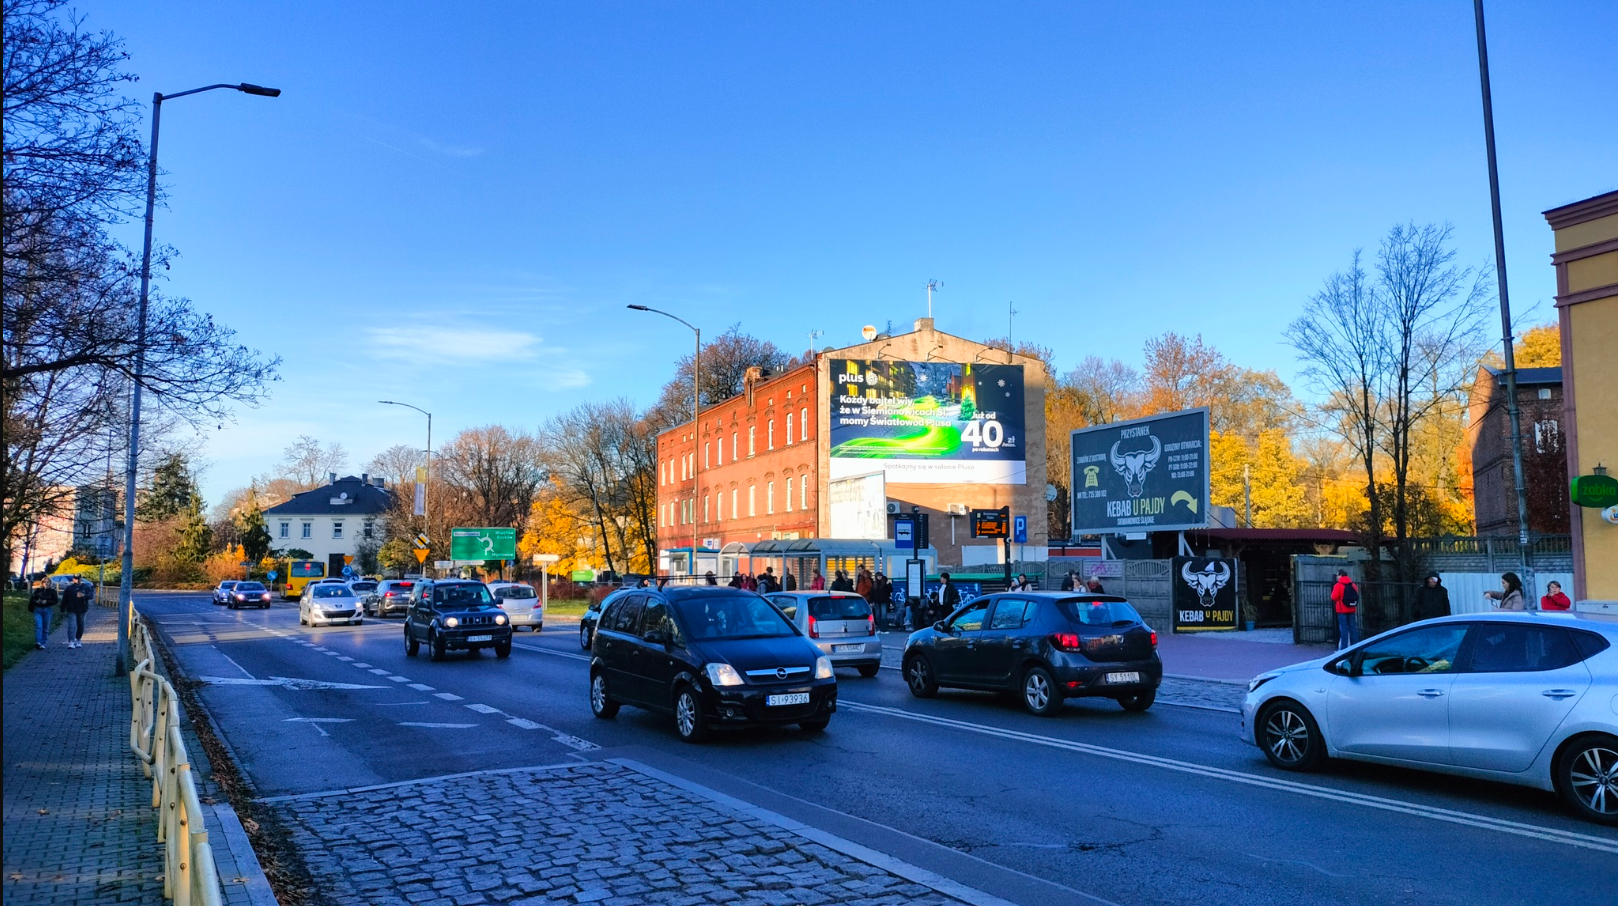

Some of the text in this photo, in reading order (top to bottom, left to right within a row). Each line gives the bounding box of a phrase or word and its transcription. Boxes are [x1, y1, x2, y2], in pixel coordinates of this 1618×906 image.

[838, 373, 864, 384] plus
[869, 396, 896, 407] bajtel
[839, 406, 852, 415] że
[861, 406, 936, 417] Siemianowicach
[972, 411, 997, 420] Już od
[839, 418, 868, 427] momy
[925, 418, 952, 427] Plusa
[961, 420, 1004, 448] 40
[1120, 425, 1150, 440] PRZYSTANEK
[1007, 435, 1016, 444] zł
[1164, 439, 1202, 453] GODZINY OTWARCIA:
[883, 463, 917, 471] Spotkajmy
[1582, 483, 1616, 496] żabka
[1107, 497, 1166, 518] KEBAB U PAJDY
[1140, 515, 1155, 526] ŚLĄSKIE
[1180, 610, 1204, 622] KEBAB
[1212, 610, 1234, 622] PAJDY
[1110, 673, 1118, 681] SY
[771, 694, 808, 705] SI 93936
